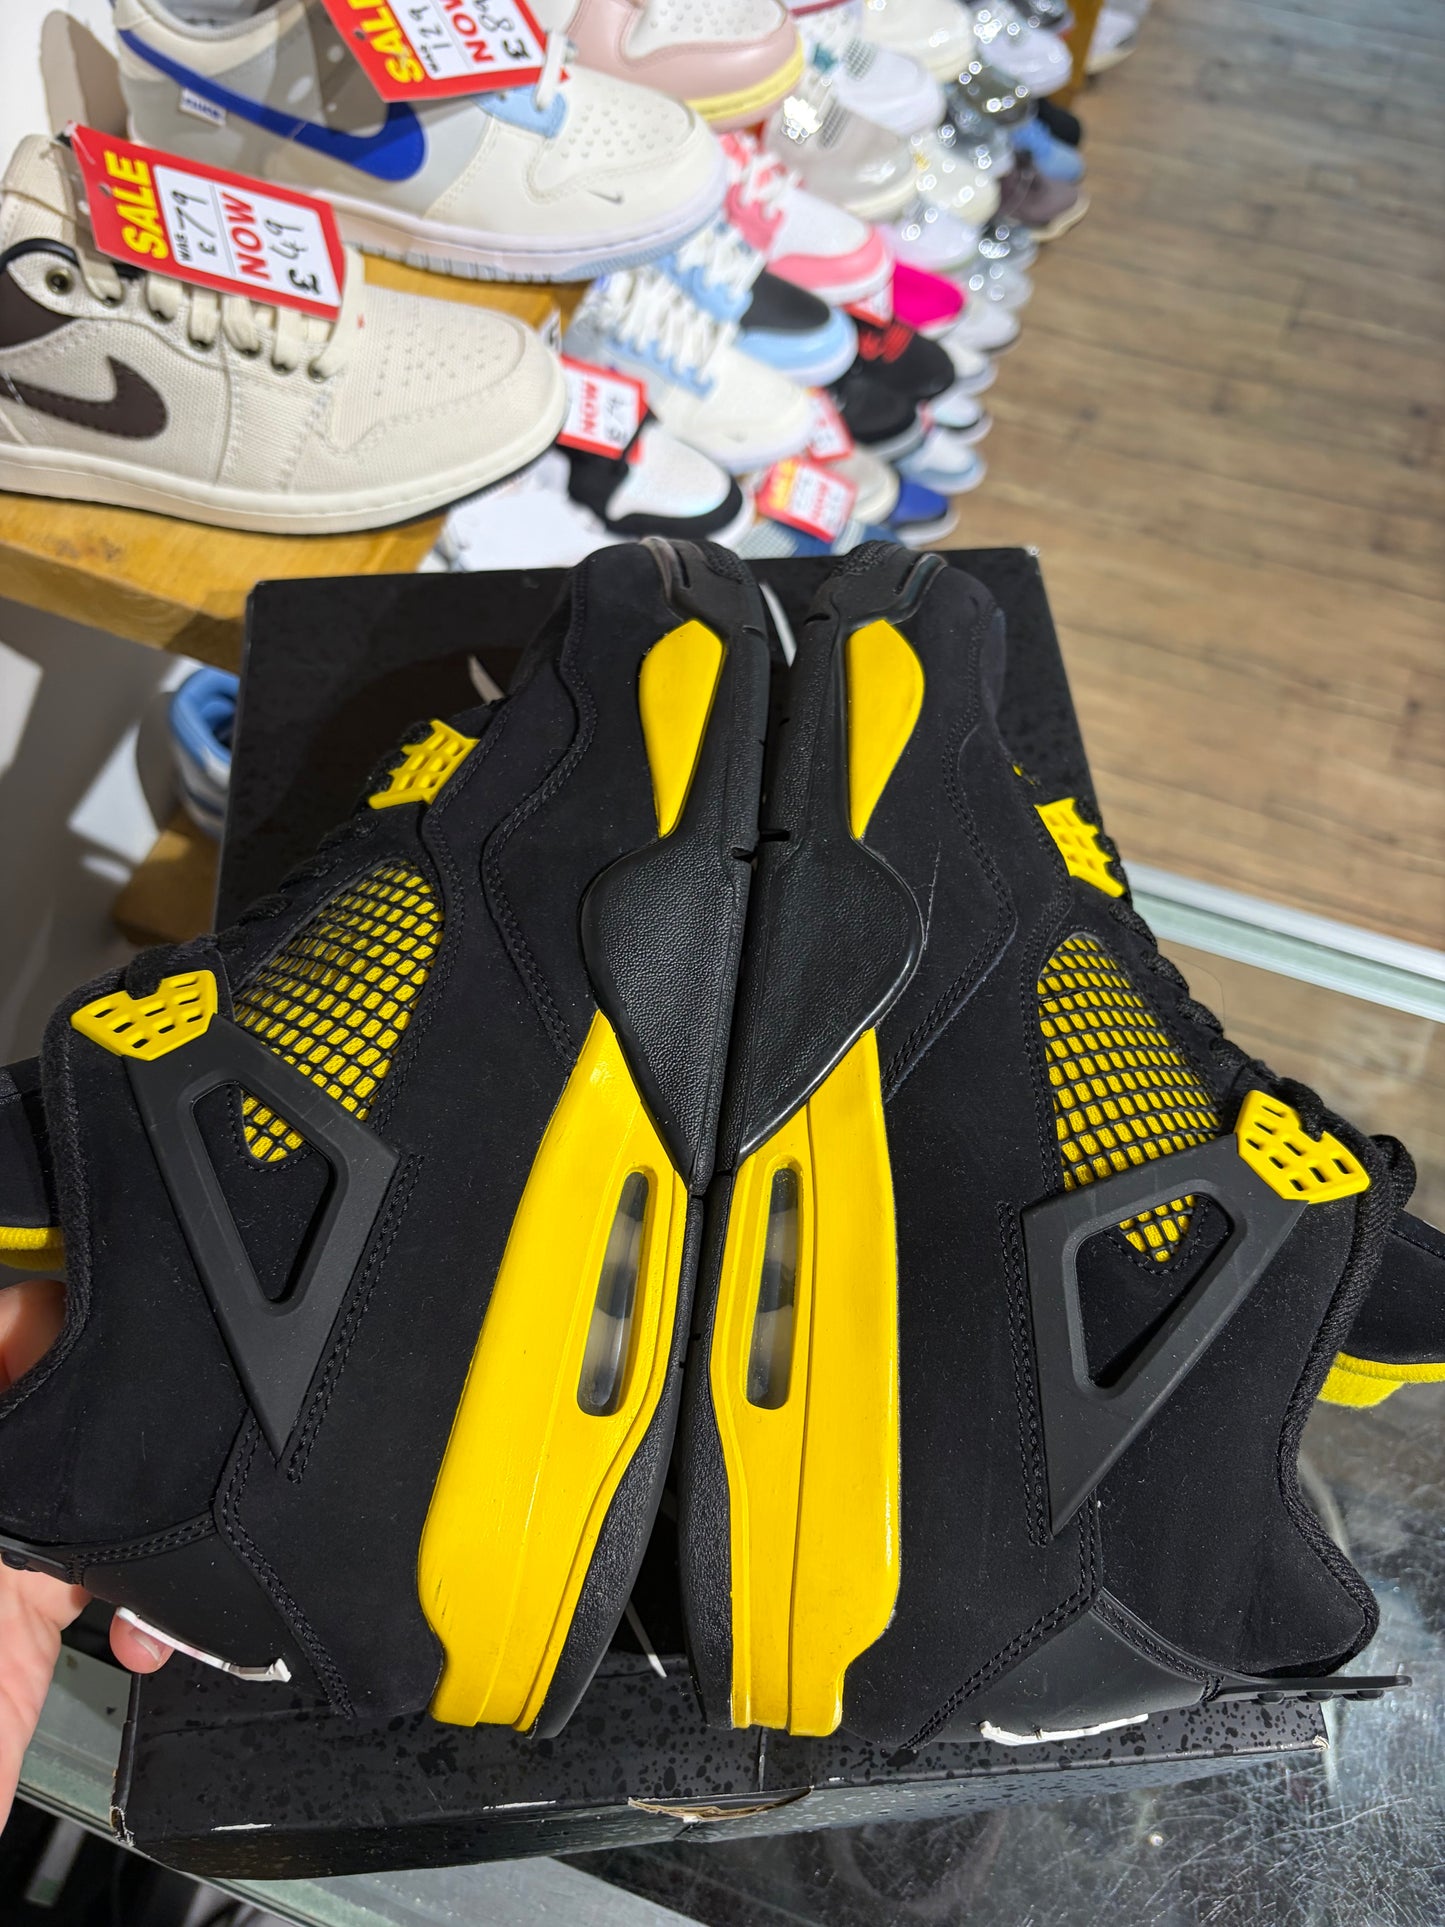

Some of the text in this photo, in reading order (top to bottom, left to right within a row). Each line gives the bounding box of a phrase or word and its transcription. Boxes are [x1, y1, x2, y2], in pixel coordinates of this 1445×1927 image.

[103, 149, 169, 260] SALE
[220, 191, 272, 281] NOW
[580, 379, 598, 436] NOW
